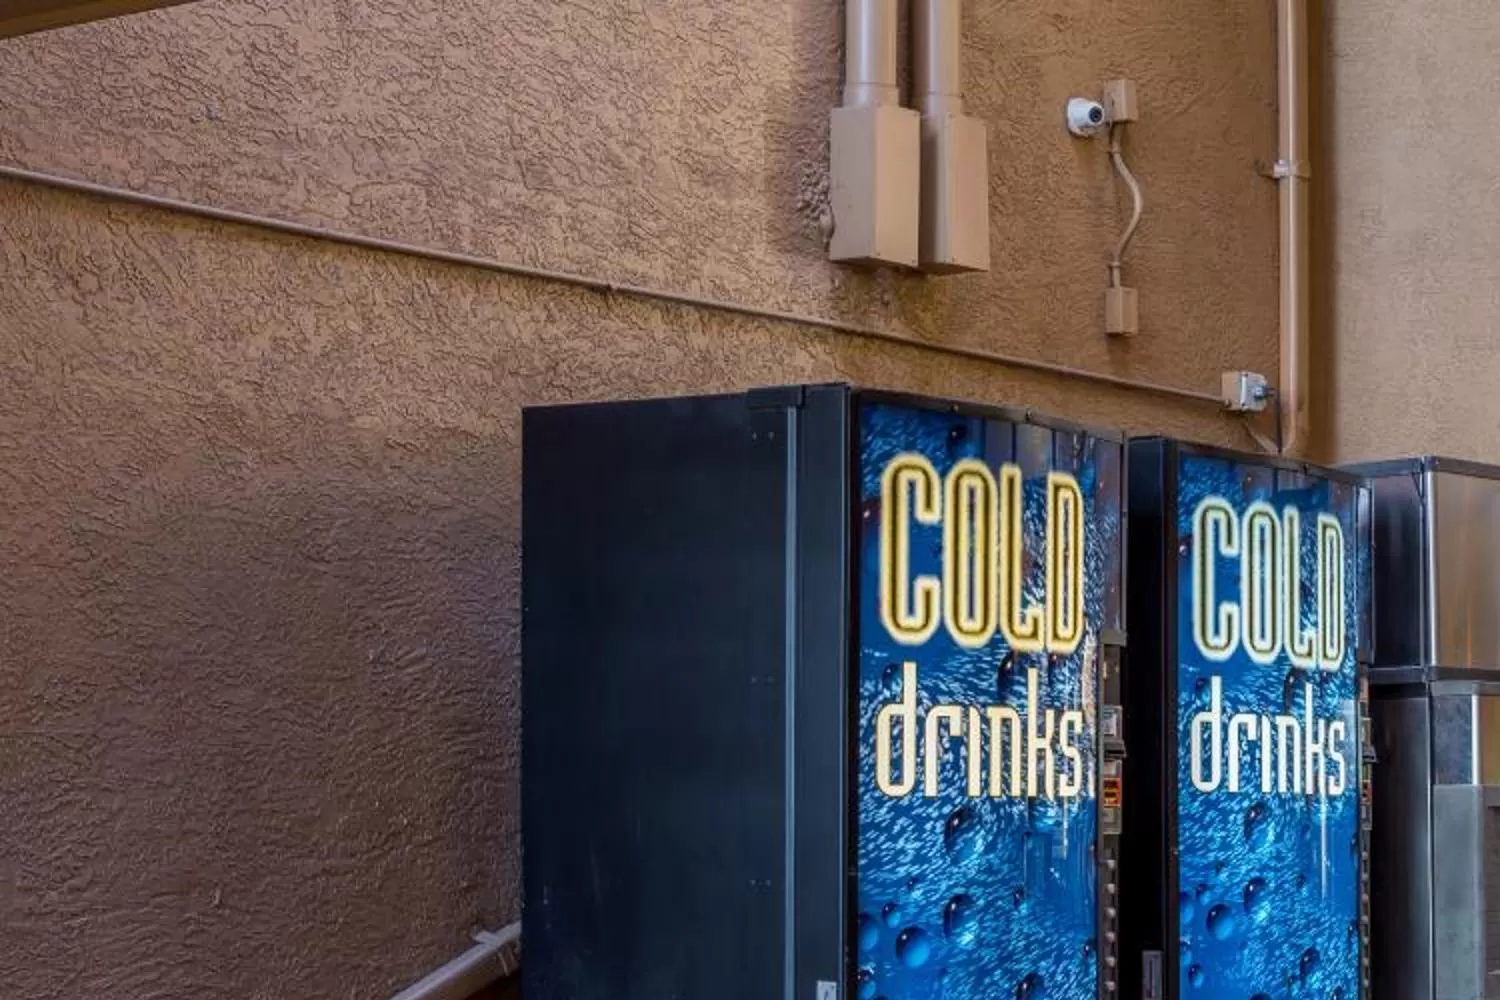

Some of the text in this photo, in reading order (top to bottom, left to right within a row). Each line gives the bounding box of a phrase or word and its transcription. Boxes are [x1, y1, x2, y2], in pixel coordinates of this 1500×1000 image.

[881, 453, 1085, 654] COLD
[1193, 496, 1345, 671] COLD
[875, 661, 1083, 797] drinks
[1191, 676, 1345, 796] drinks
